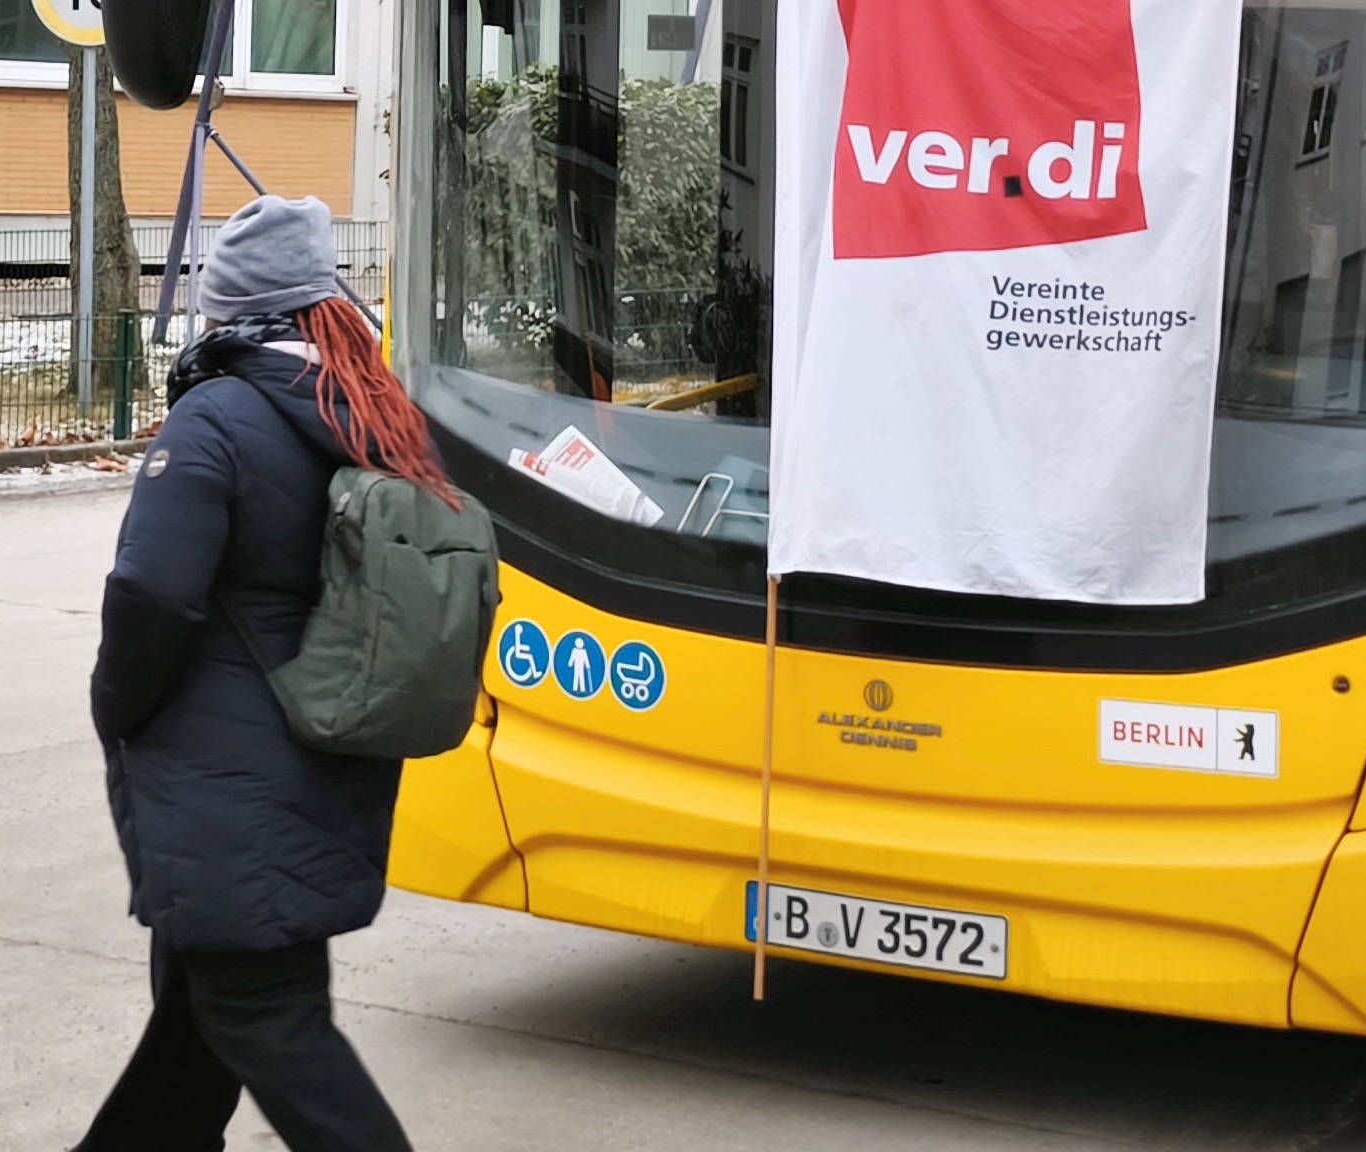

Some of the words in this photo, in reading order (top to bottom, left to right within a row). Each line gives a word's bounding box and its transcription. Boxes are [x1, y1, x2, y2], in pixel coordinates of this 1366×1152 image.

[847, 120, 1125, 200] ver.di
[992, 275, 1106, 301] Vereinte
[989, 300, 1197, 330] Dienstleistungs-
[986, 330, 1163, 353] gewerkschaft
[817, 712, 942, 737] ALEXANDER
[1113, 720, 1204, 748] BERLIN
[786, 895, 809, 939] B
[840, 903, 864, 948] V
[877, 910, 984, 966] 3572
